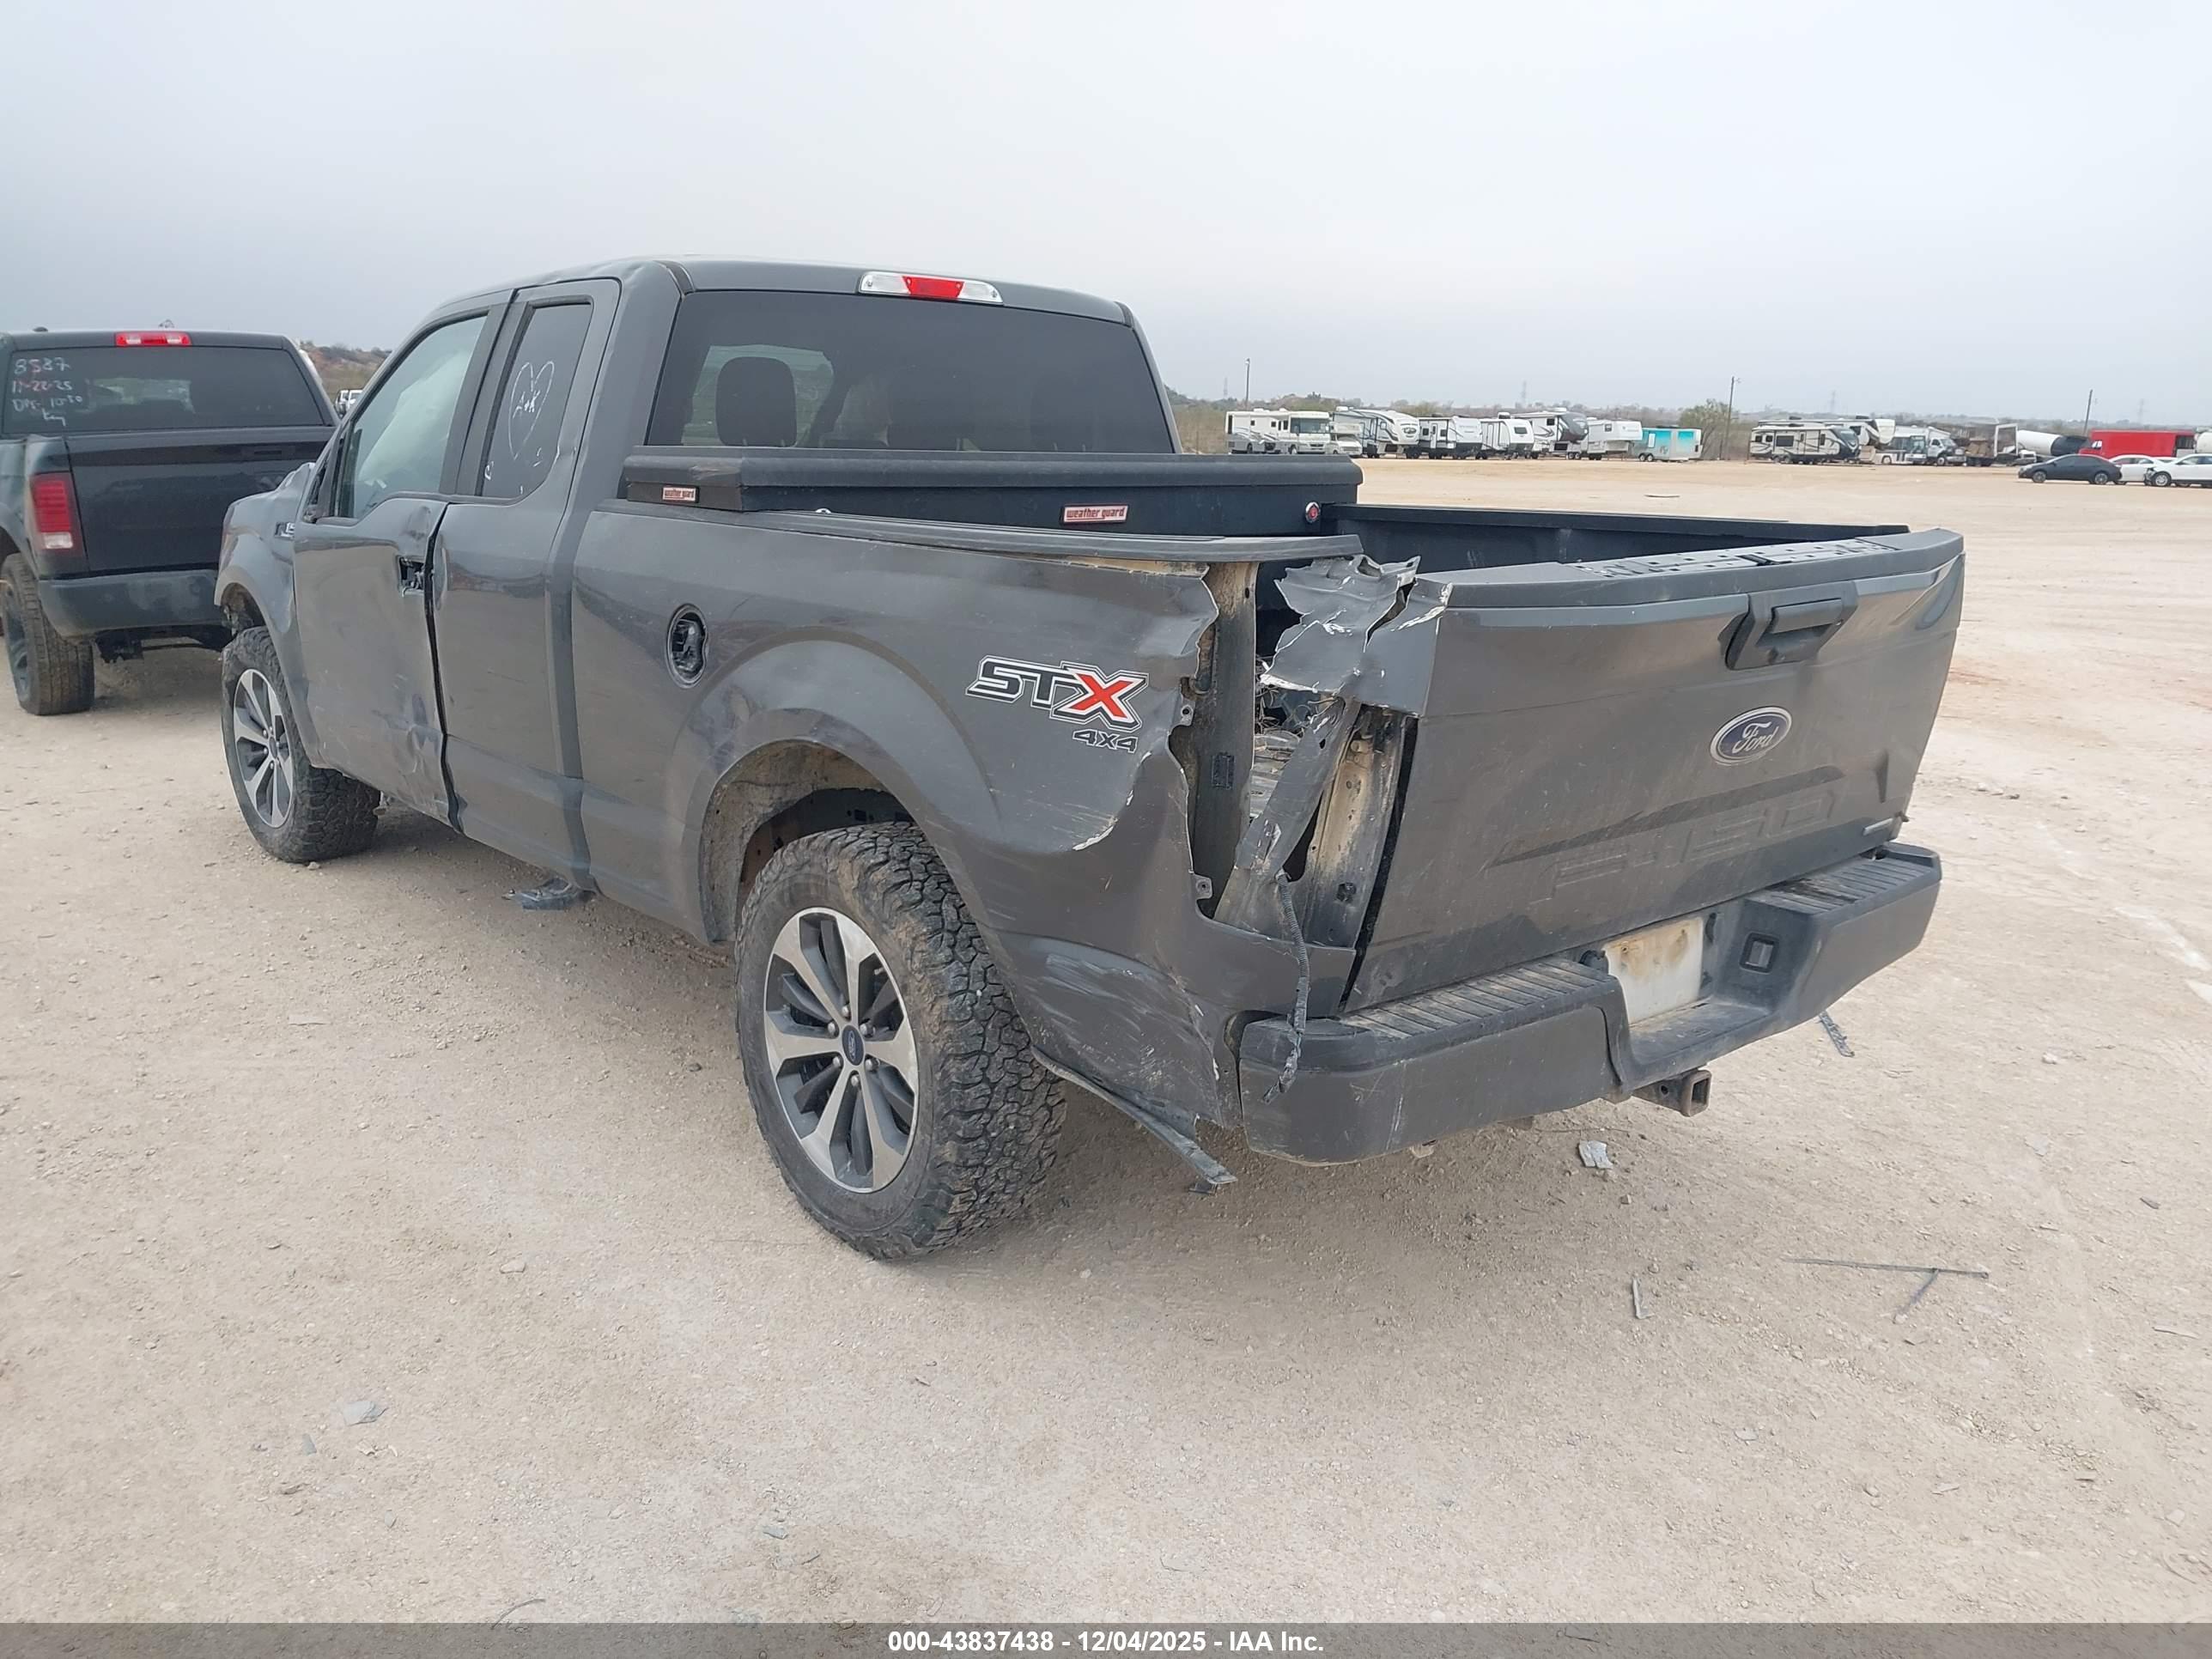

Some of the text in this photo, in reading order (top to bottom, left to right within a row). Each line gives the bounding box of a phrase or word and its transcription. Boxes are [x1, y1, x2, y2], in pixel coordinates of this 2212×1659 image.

[1066, 507, 1126, 519] weather guard
[965, 655, 1149, 733] STX
[1731, 721, 1778, 754] Ford
